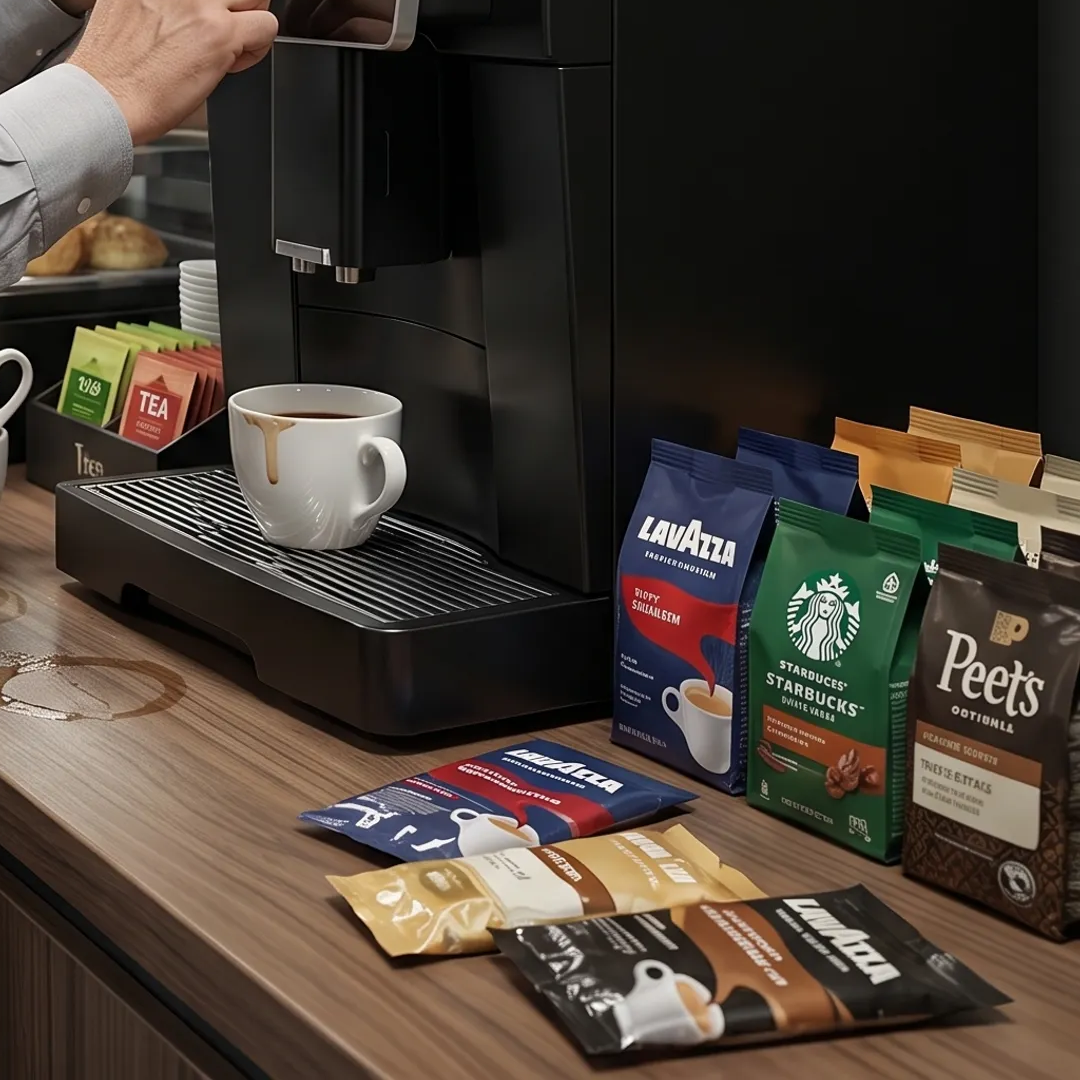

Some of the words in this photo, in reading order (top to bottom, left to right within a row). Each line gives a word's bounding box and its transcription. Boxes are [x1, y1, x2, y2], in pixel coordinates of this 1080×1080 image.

[139, 390, 168, 420] TEA
[637, 515, 737, 568] LAVAZZA
[765, 672, 859, 718] STARBUCKS
